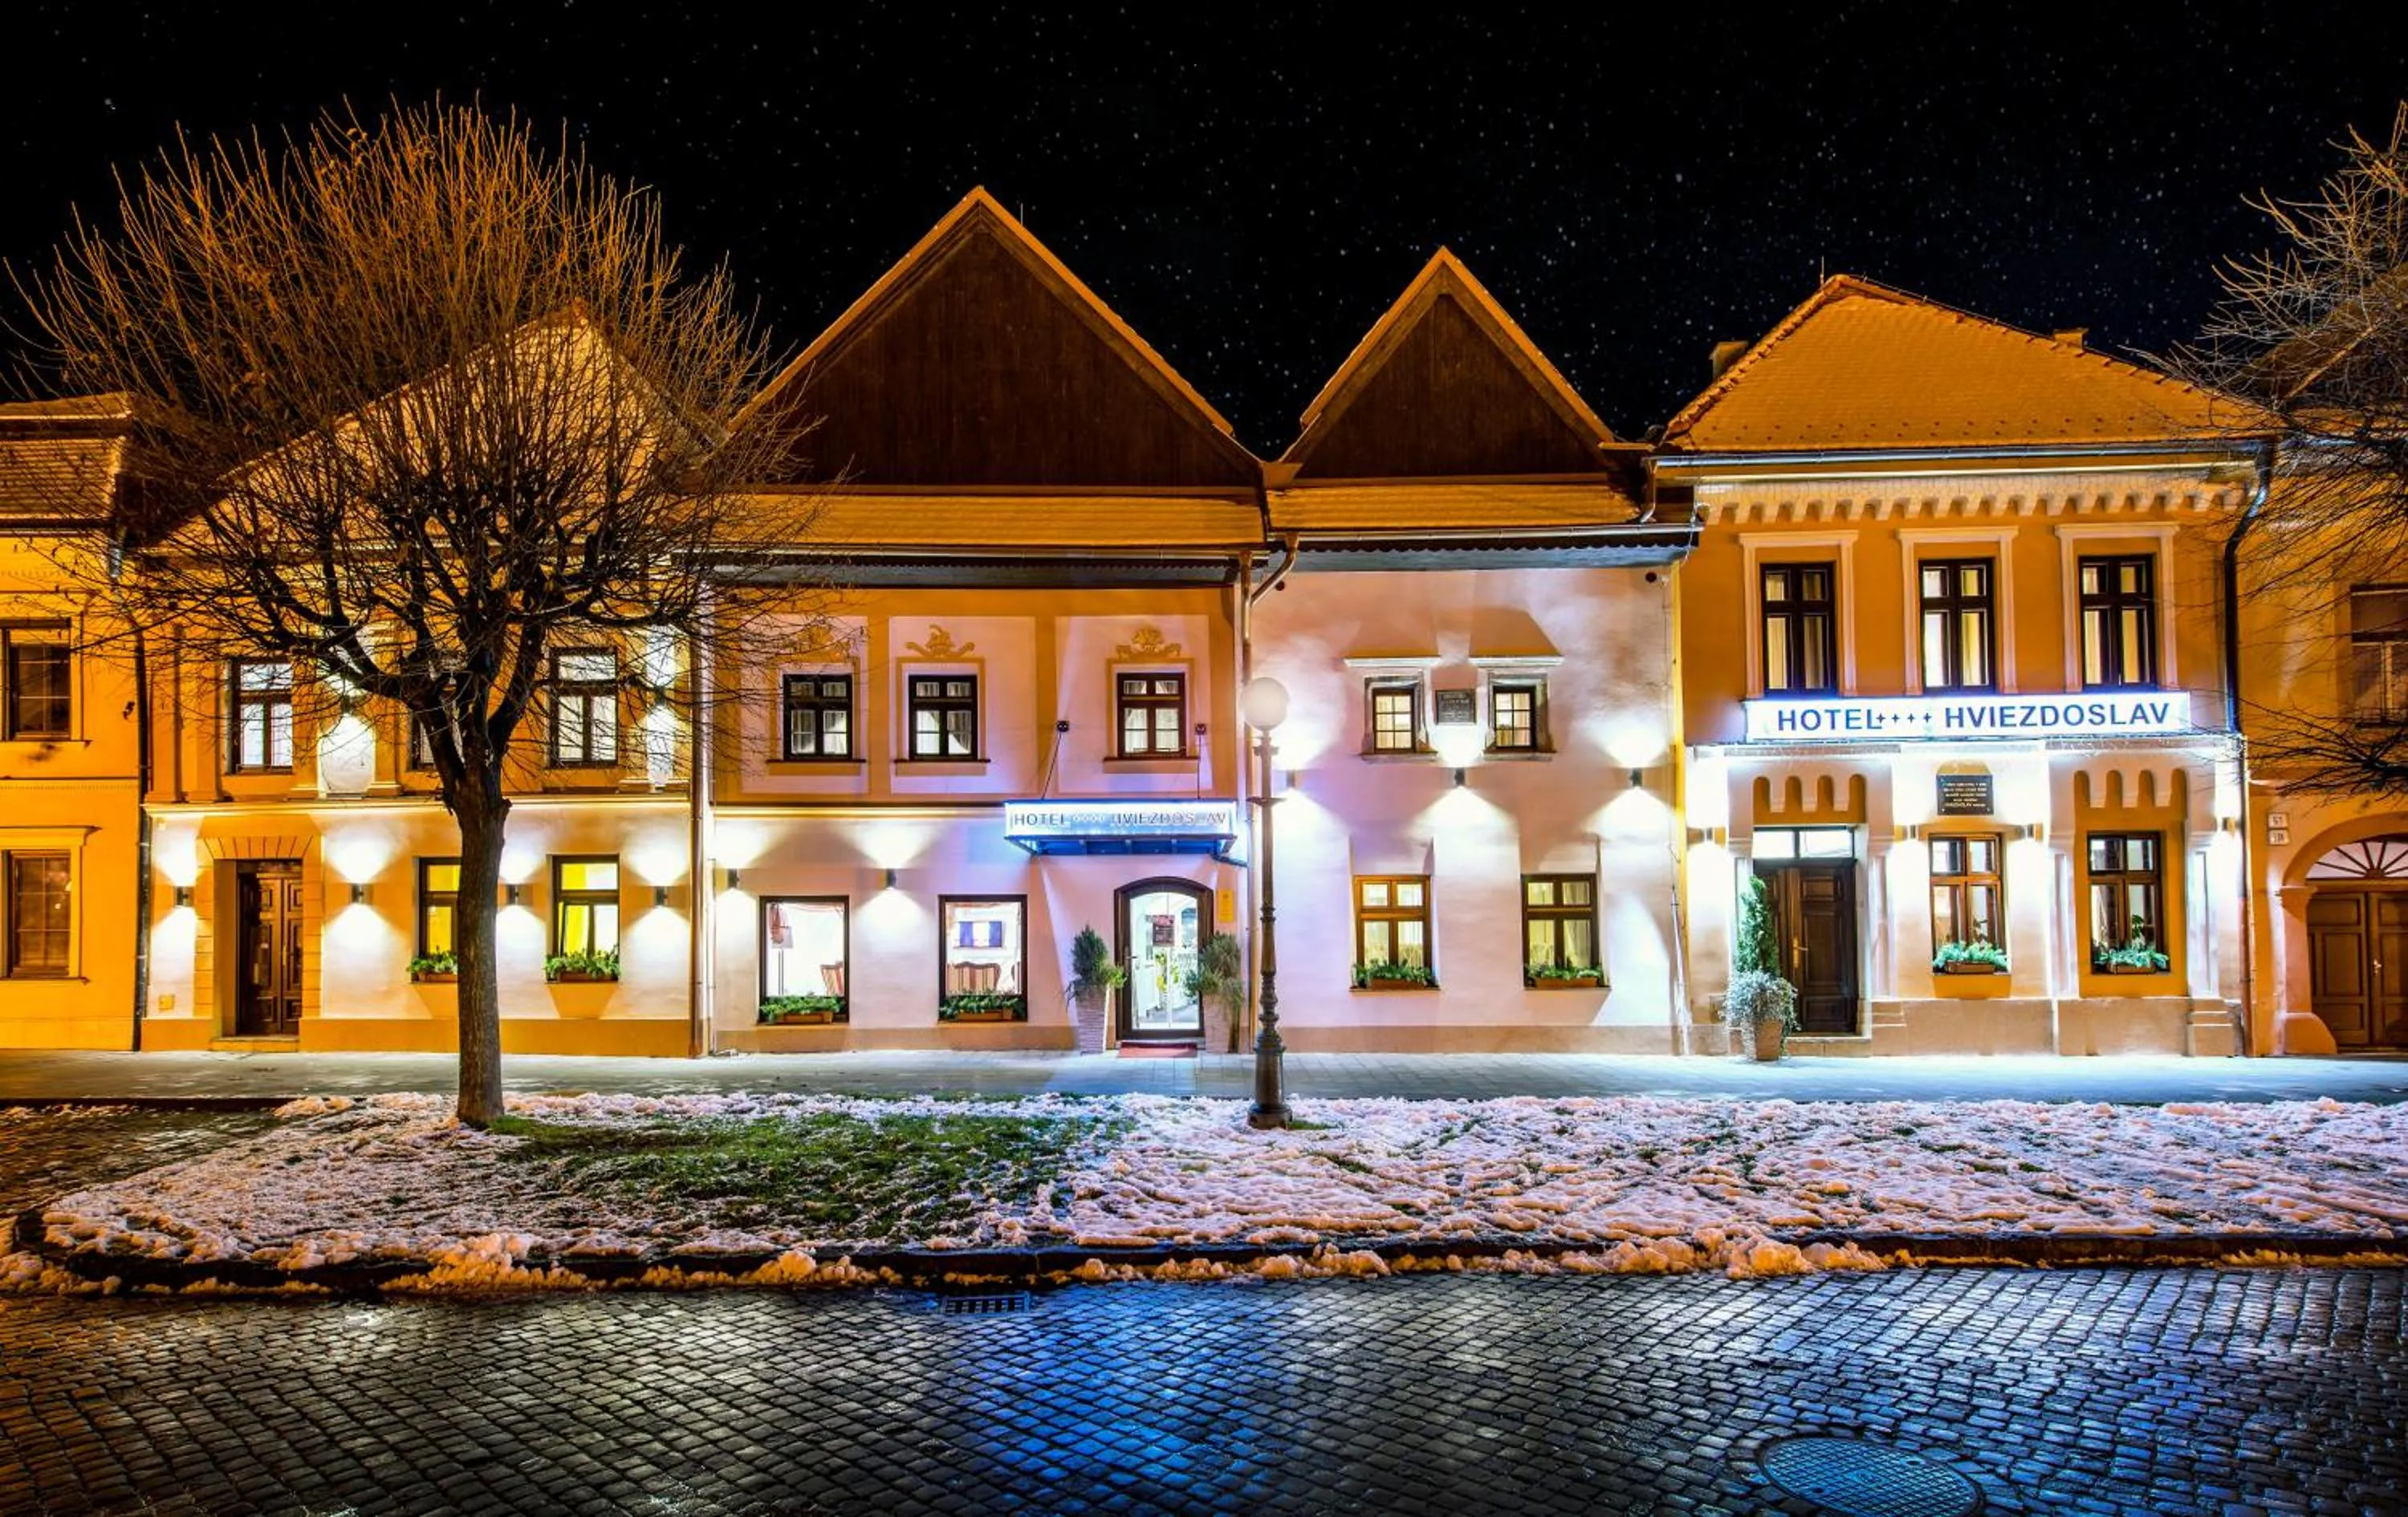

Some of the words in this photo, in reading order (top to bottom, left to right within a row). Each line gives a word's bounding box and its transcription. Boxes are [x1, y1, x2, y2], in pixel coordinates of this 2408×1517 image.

[1777, 709, 1882, 731] HOTEL
[1944, 703, 2170, 728] HVIEZDOSLAV
[1014, 813, 1070, 825] HOTEL
[1112, 812, 1226, 824] HVIEZDOSAV
